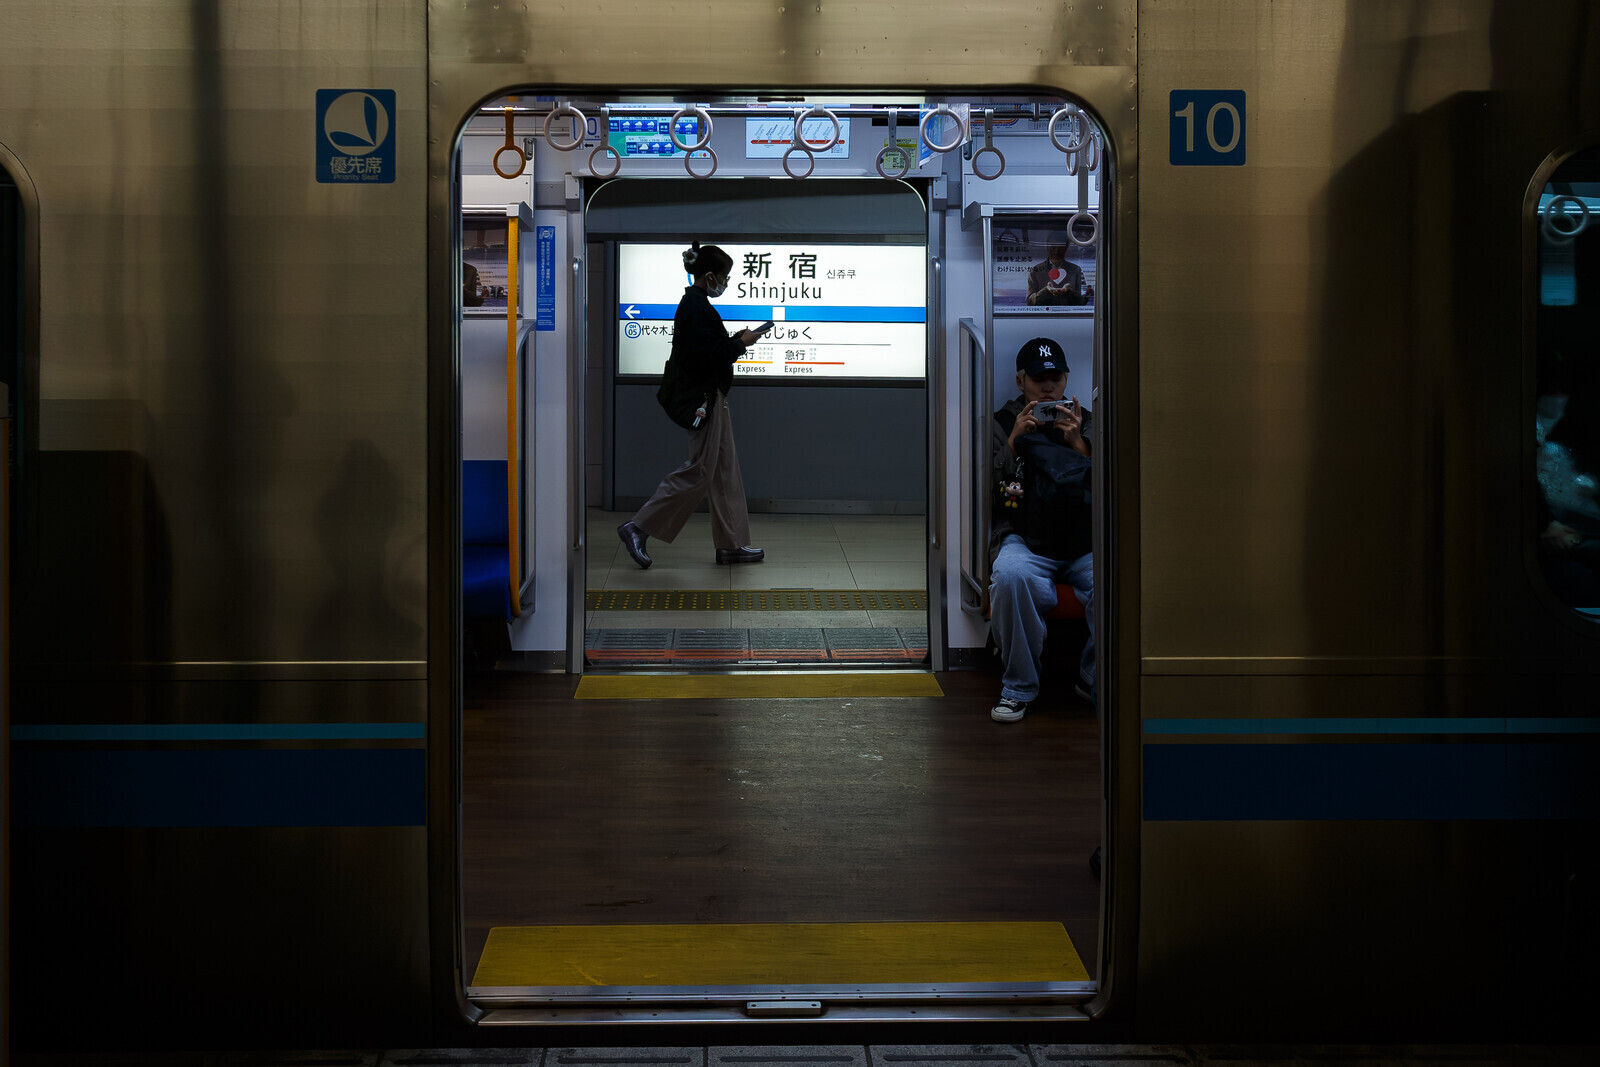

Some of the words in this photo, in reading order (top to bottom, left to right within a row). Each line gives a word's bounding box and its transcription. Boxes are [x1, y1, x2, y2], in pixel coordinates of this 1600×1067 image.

[1175, 101, 1241, 153] 10
[331, 156, 383, 174] 優先席
[743, 252, 817, 279] 新宿
[826, 269, 857, 280] 신쥬쿠
[737, 281, 822, 303] Shinjuku
[784, 349, 806, 361] 急行
[1039, 345, 1053, 357] NY
[737, 365, 766, 374] Express
[784, 366, 813, 374] Express
